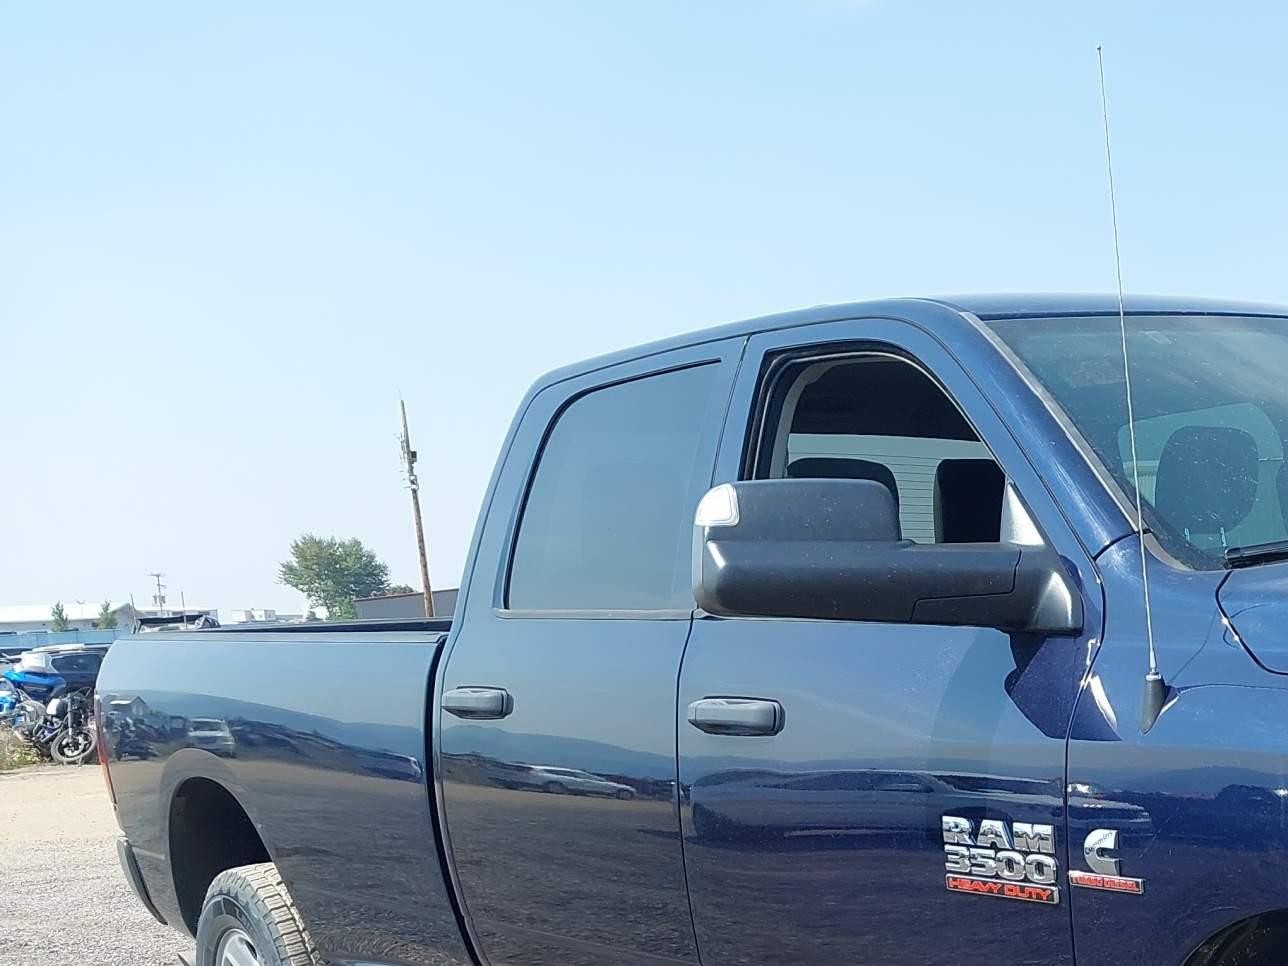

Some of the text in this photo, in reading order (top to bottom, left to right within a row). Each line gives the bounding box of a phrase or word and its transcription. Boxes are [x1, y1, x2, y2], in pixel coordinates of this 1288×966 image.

[942, 816, 1056, 853] RAM
[944, 845, 1058, 884] 3500
[949, 877, 1052, 901] HEAVY DUTY
